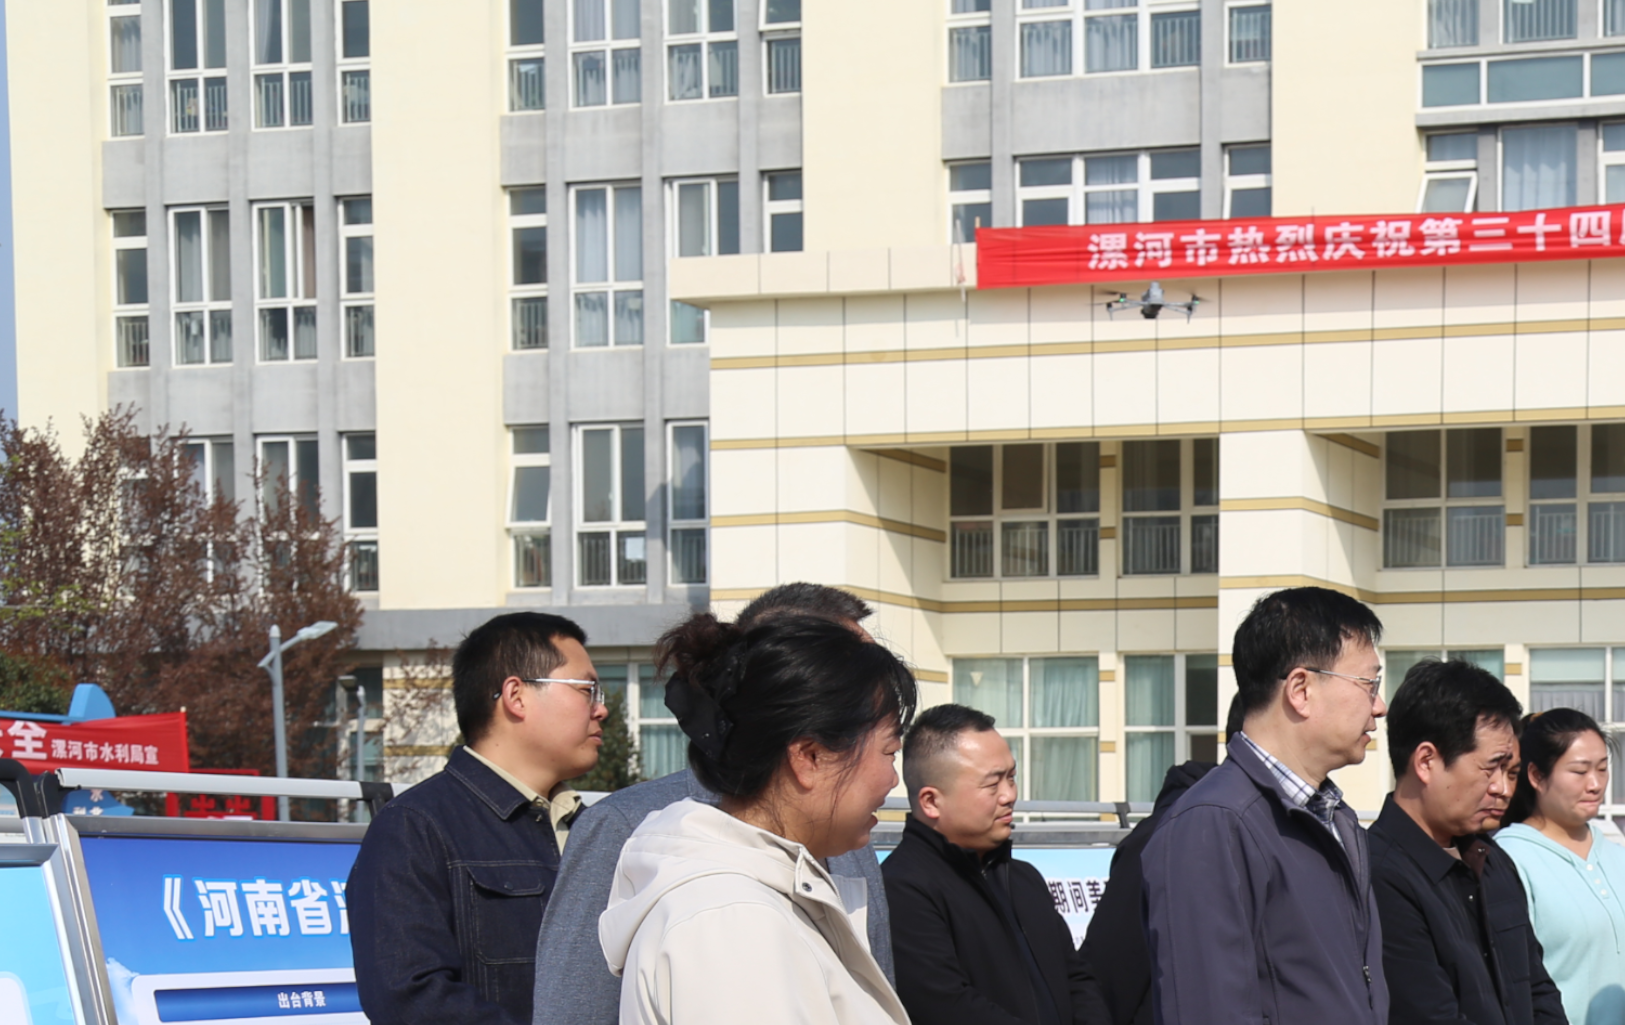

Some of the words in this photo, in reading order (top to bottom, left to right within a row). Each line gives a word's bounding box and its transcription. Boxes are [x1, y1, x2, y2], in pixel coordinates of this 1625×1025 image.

[0, 720, 48, 760] 全
[51, 738, 159, 766] 漯河市水利局宣
[277, 990, 326, 1009] 出台背景
